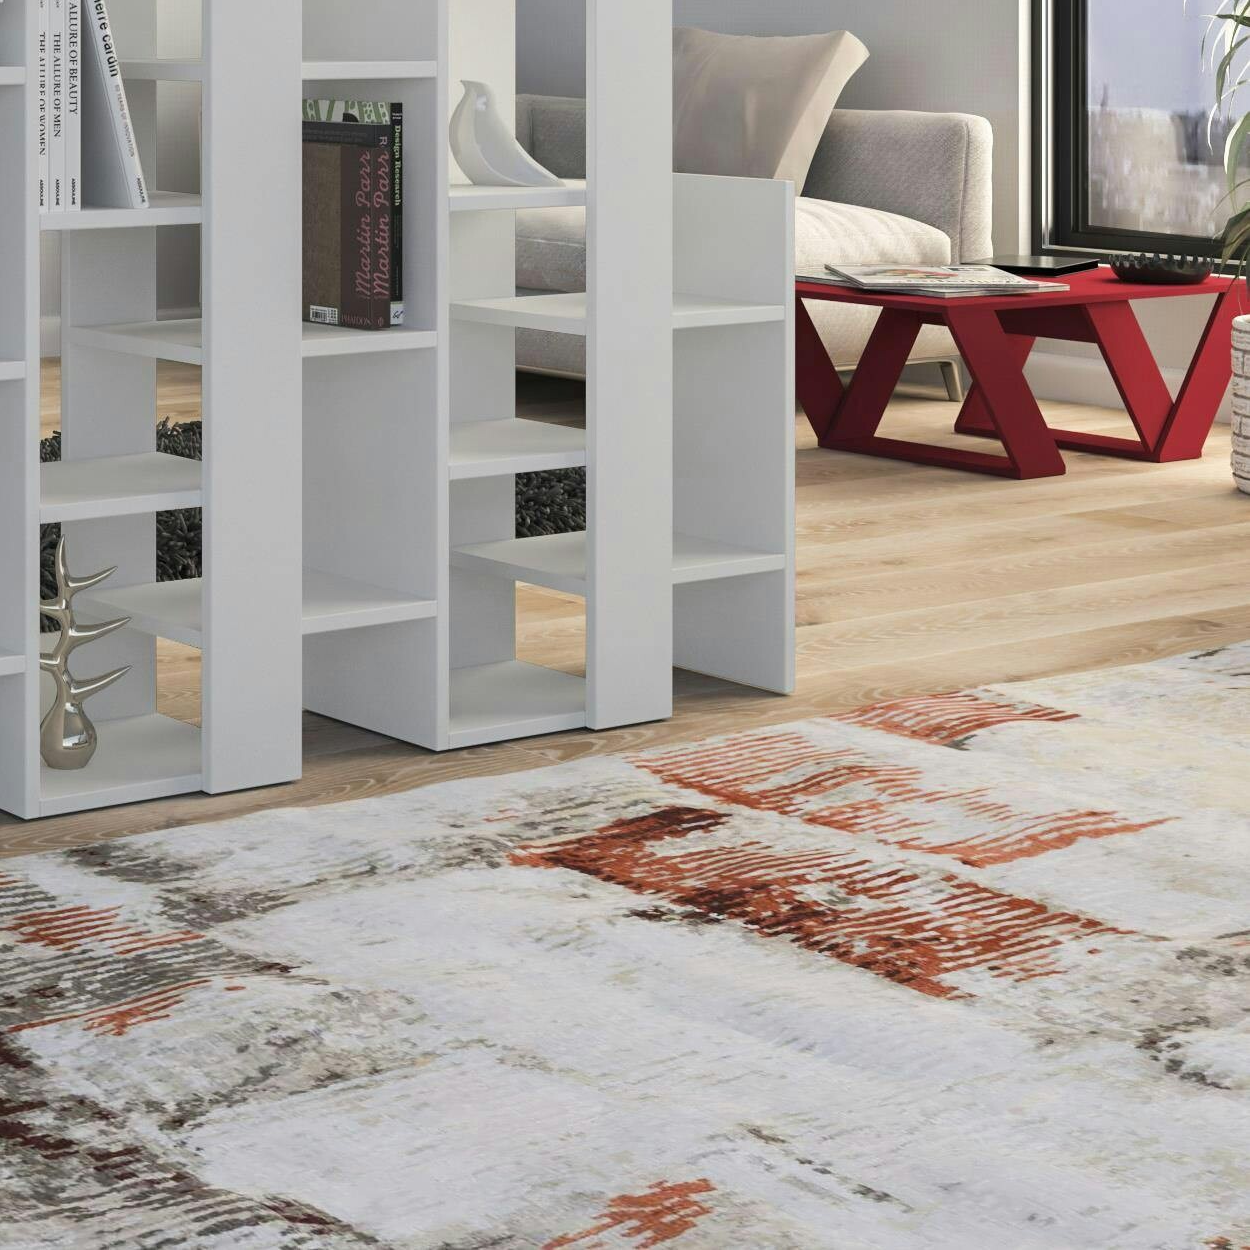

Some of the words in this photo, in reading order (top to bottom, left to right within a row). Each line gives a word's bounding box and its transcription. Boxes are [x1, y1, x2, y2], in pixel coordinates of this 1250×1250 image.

[53, 31, 61, 53] THE
[69, 1, 78, 48] ALLURE
[53, 55, 61, 97] ALLURE
[69, 49, 78, 65] OF
[102, 34, 119, 78] cardin
[53, 98, 61, 112] OF
[69, 68, 78, 115] BEAUTY
[53, 113, 61, 138] MEN
[393, 125, 401, 158] Design
[355, 150, 371, 208] Parr
[373, 150, 390, 208] Parr
[393, 161, 401, 206] Research
[355, 214, 371, 299] Martin
[373, 214, 390, 299] Martin
